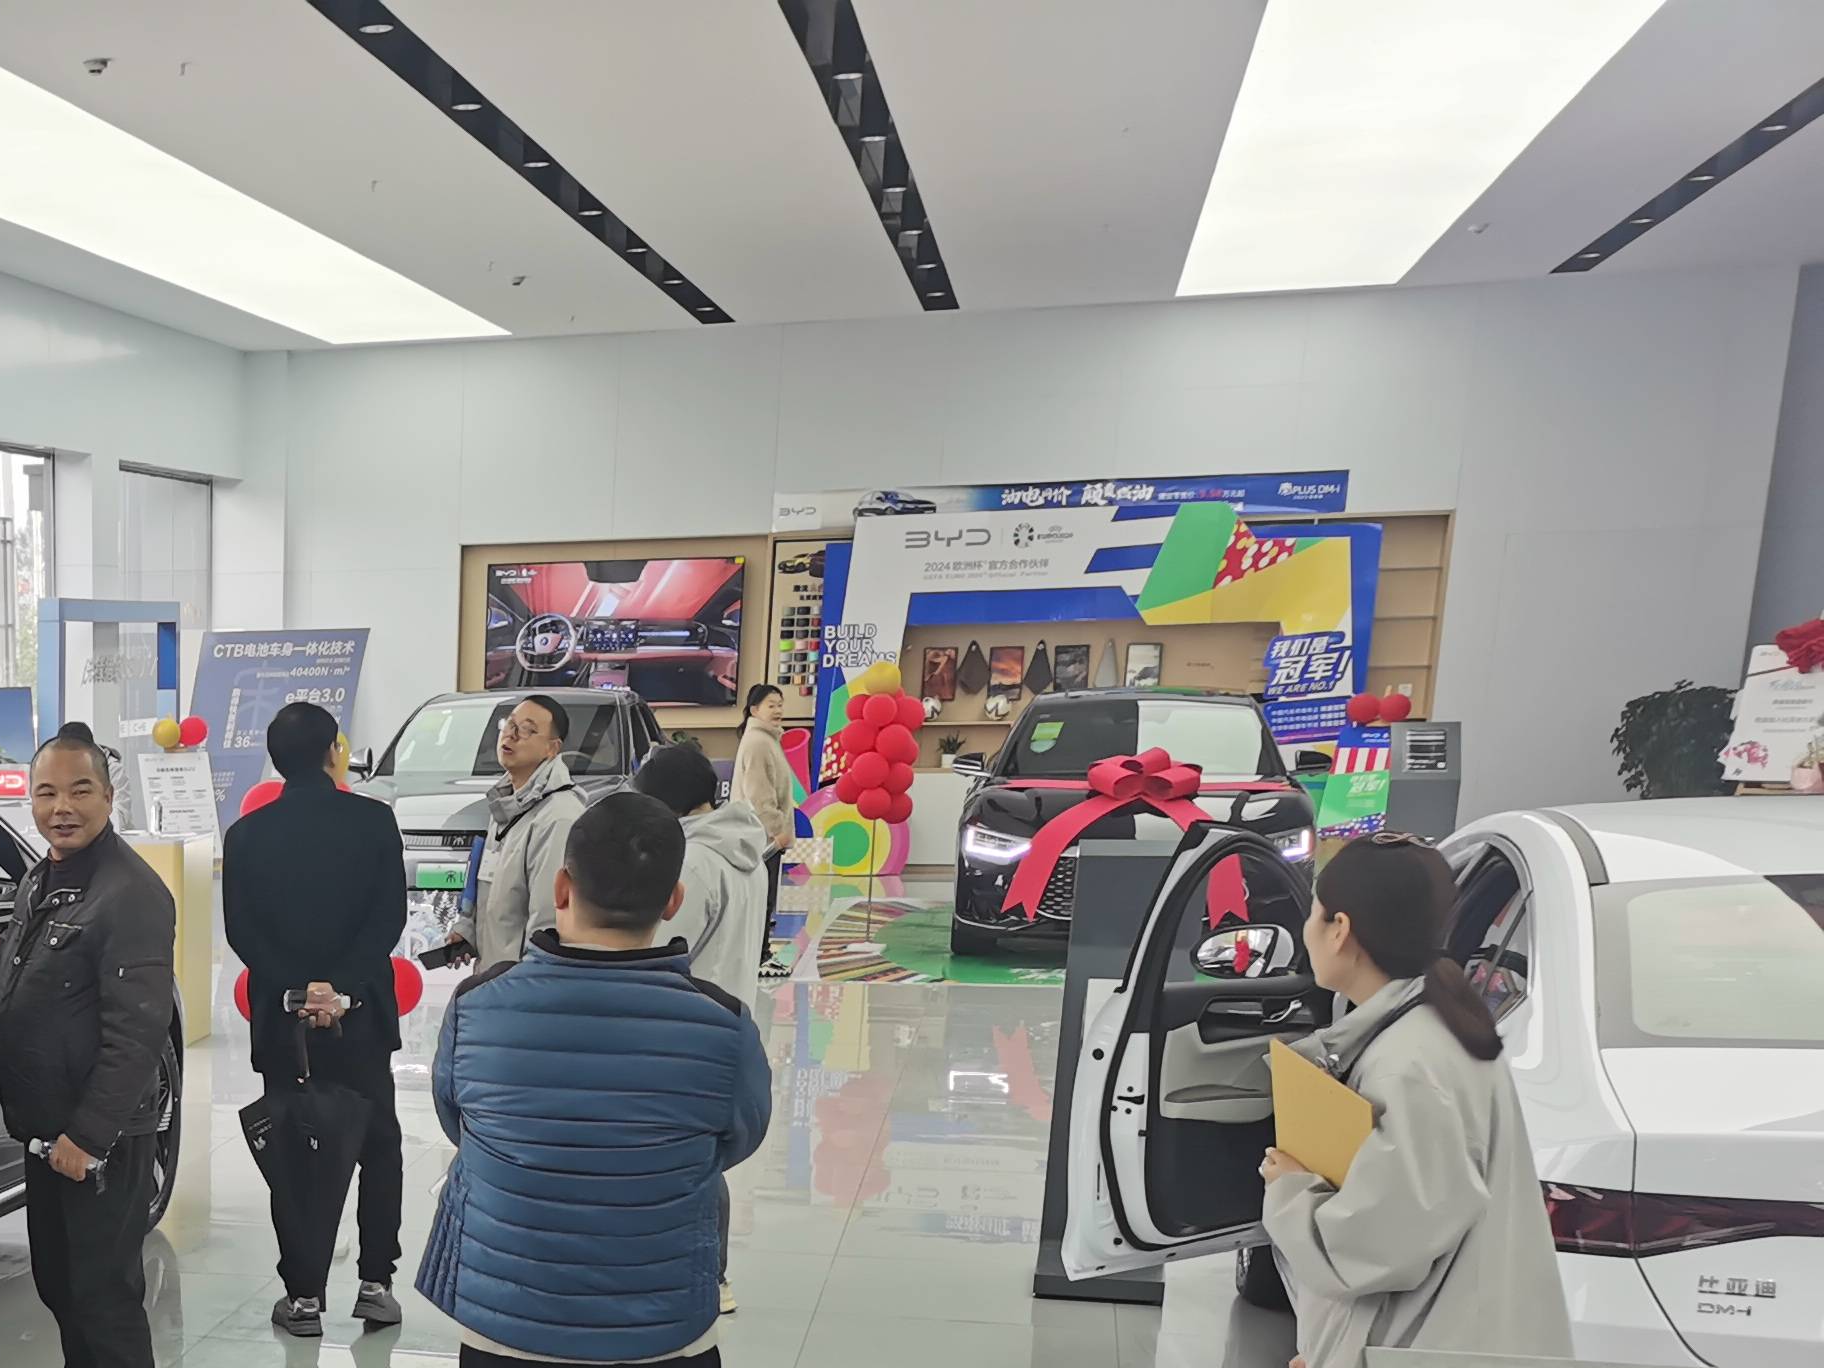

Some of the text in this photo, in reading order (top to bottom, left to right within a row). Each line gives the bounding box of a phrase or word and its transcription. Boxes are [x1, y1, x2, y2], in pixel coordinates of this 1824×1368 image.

[779, 506, 816, 516] BYD
[905, 529, 991, 548] BYD
[925, 562, 951, 572] 2024
[825, 624, 877, 639] BUILD
[213, 640, 356, 658] CTB电池车身一体化技术
[826, 640, 874, 653] YOUR
[1267, 686, 1284, 695] WE
[1284, 683, 1308, 693] ARE
[234, 736, 252, 748] 36
[1697, 1275, 1776, 1298] 比亚迪
